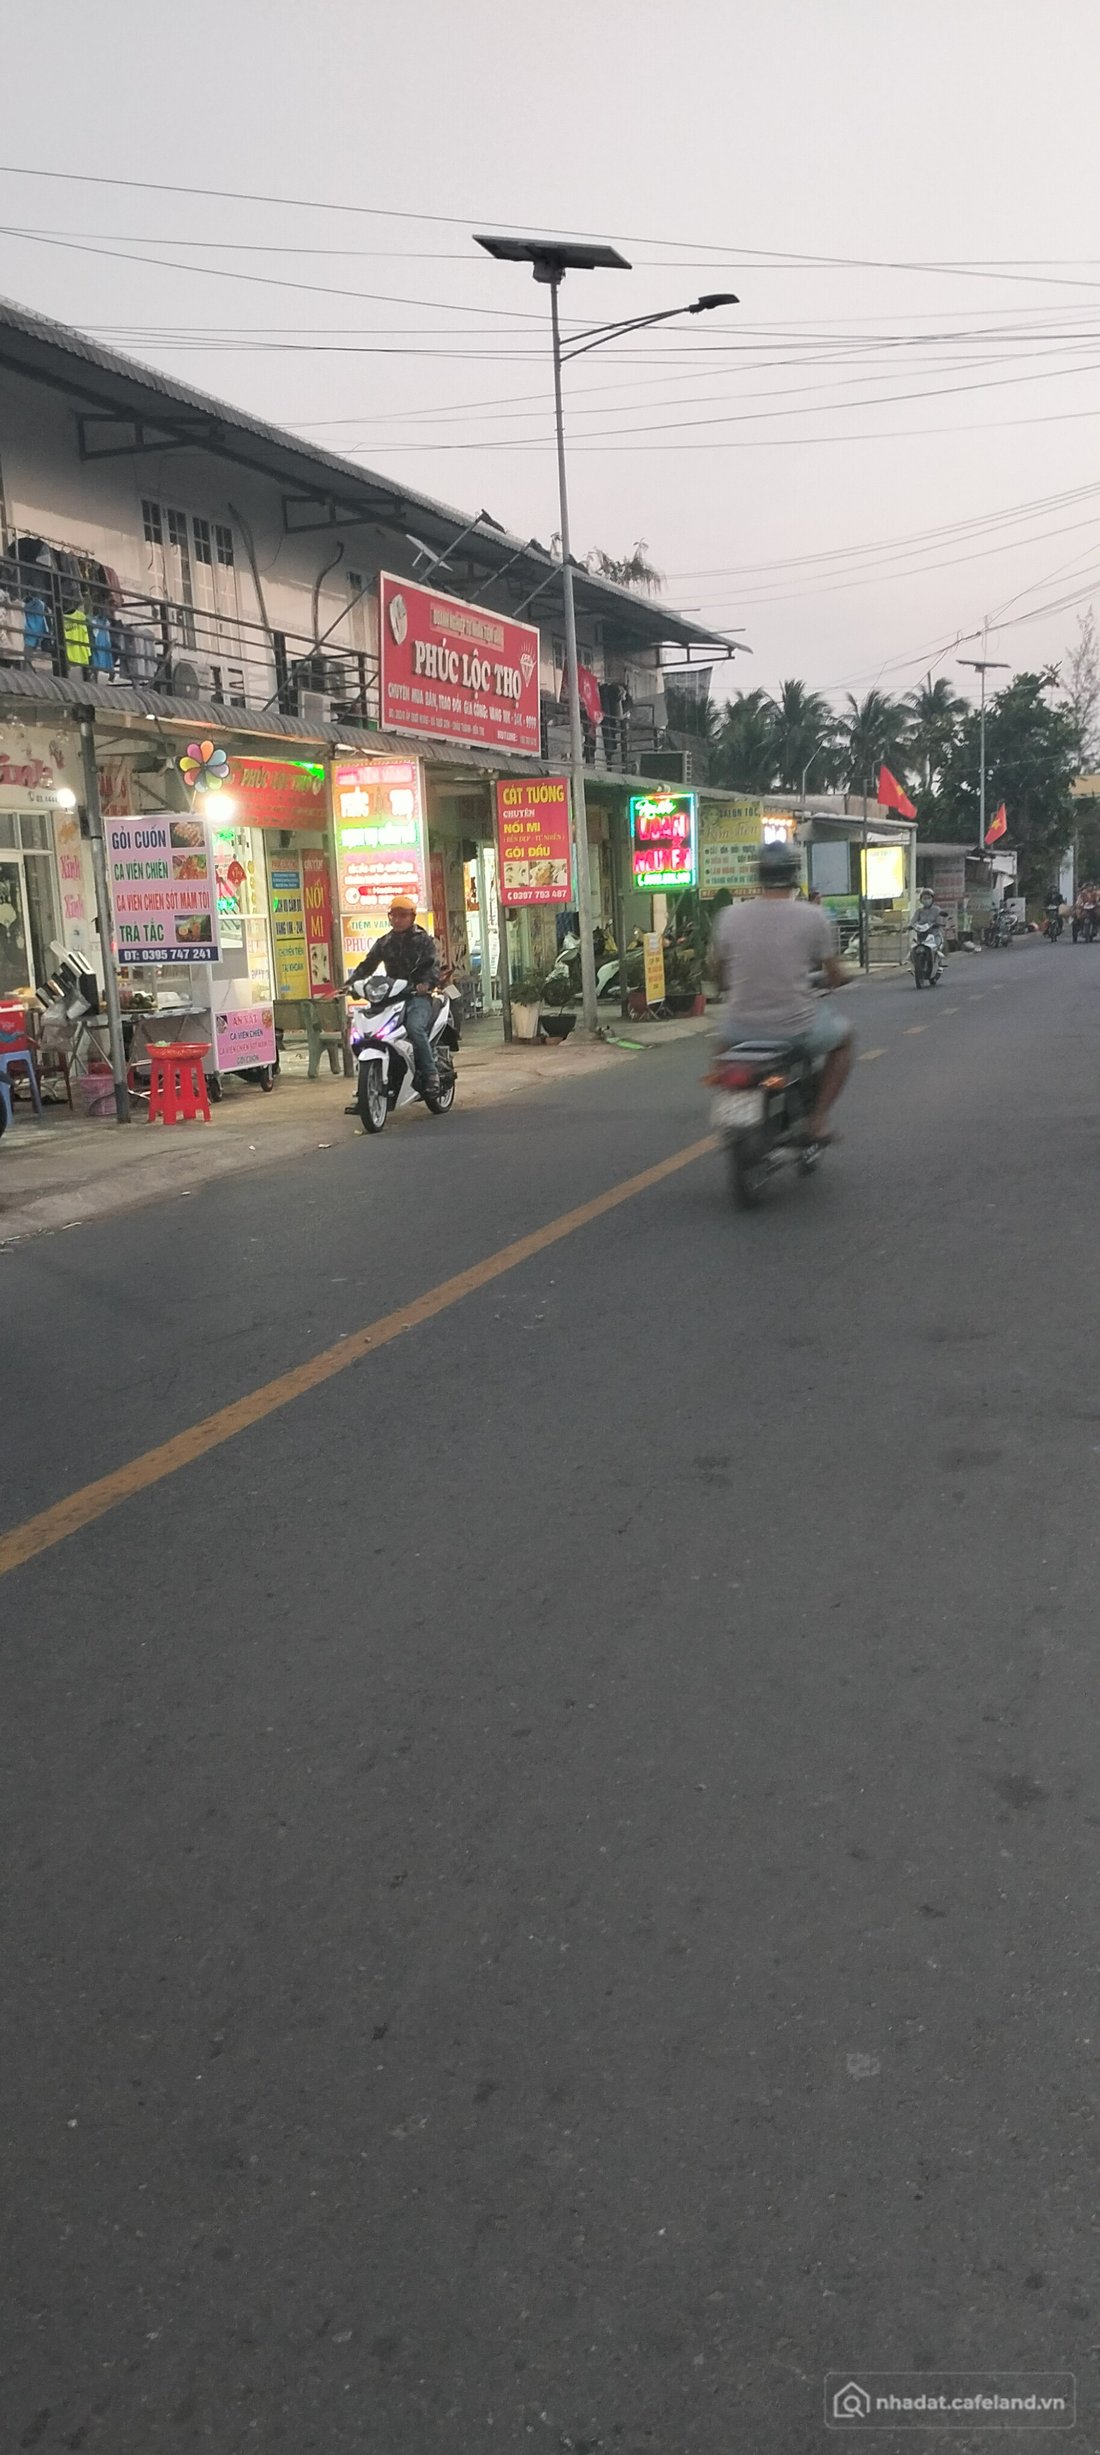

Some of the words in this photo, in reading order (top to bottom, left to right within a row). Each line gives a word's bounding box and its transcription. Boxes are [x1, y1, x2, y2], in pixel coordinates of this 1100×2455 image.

[414, 638, 459, 684] PHÚC
[463, 648, 491, 700] LỘC
[494, 664, 522, 708] THỌ
[503, 808, 535, 818] CHUYÊN
[111, 825, 131, 849] GỎI
[134, 824, 167, 848] CUỐN
[503, 820, 524, 833] NỐI
[527, 822, 541, 832] MI
[505, 845, 525, 859] GỘI
[126, 858, 143, 880] VIÊN
[145, 858, 168, 879] CHIÊN
[305, 880, 325, 909] NỐI
[119, 921, 140, 942] TRÀ
[143, 917, 164, 942] TẮC
[311, 916, 324, 937] MI
[374, 919, 390, 929] VÀN
[124, 951, 140, 961] ĐT:
[142, 950, 168, 960] 0395
[170, 949, 190, 960] 747
[193, 948, 211, 959] 241
